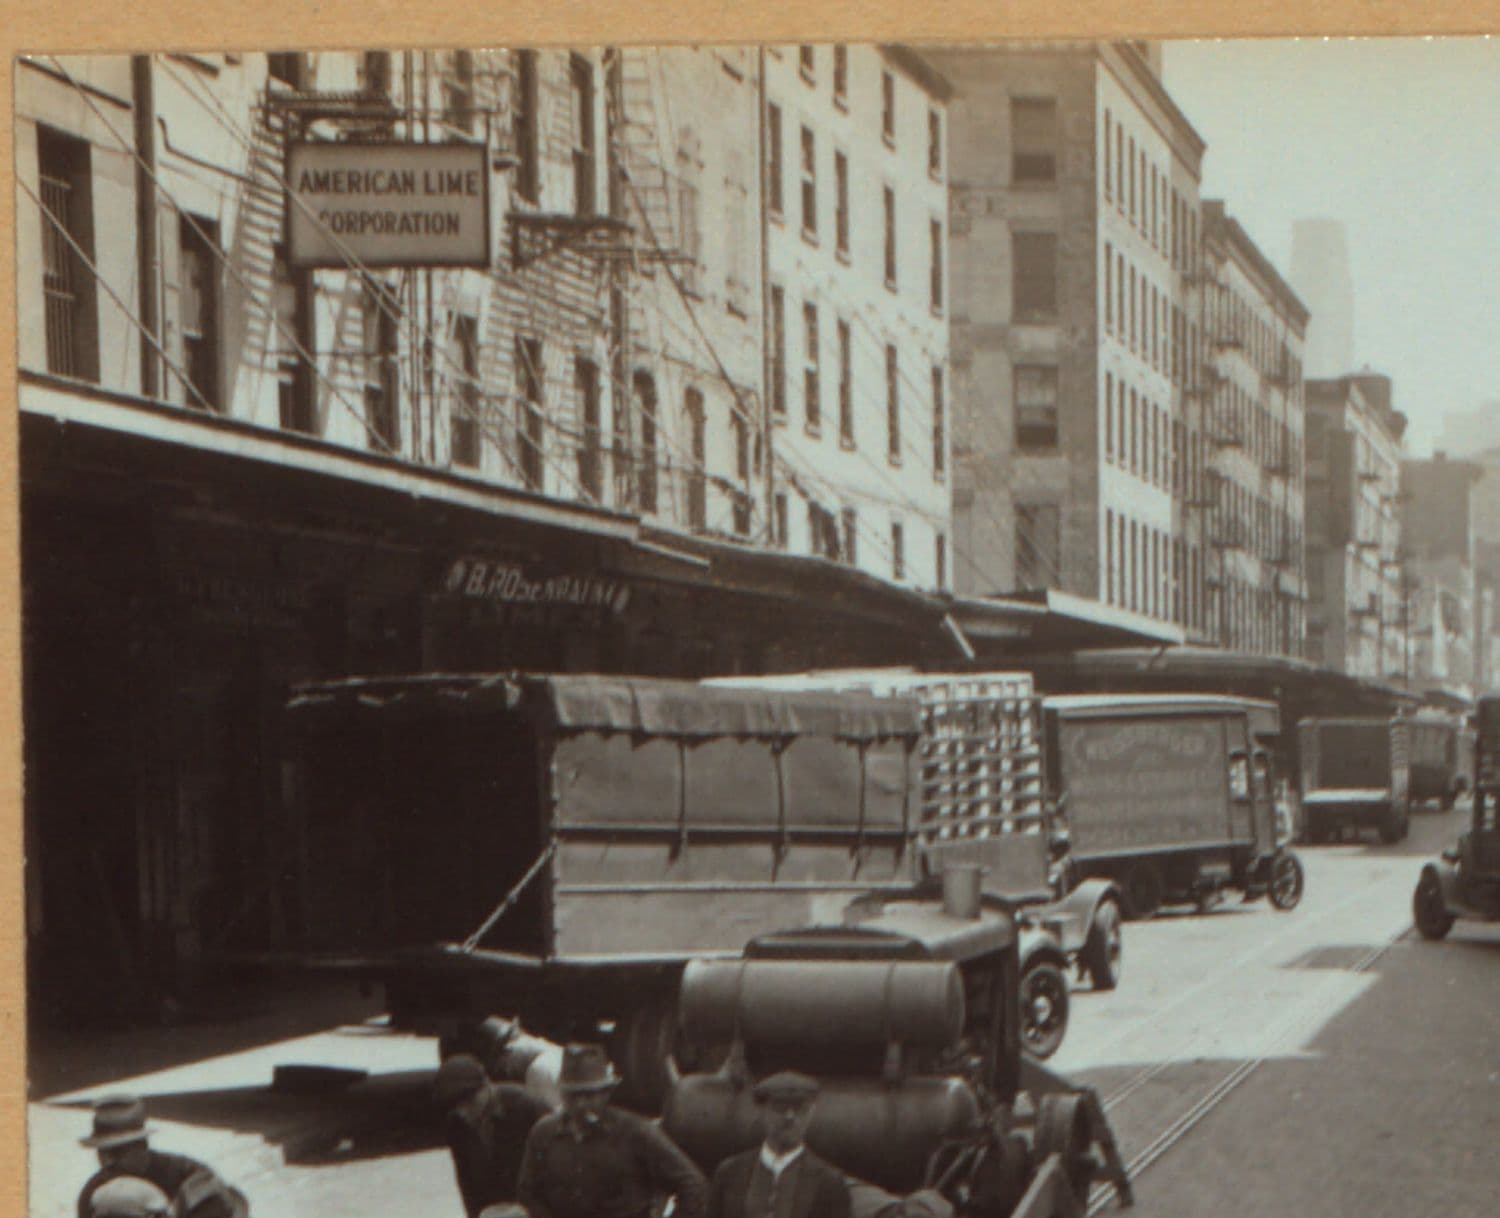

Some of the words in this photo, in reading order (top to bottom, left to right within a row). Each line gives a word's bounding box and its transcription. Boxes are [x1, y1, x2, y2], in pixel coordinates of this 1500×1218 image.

[299, 169, 416, 195] AMERICAN
[424, 170, 480, 197] LIME
[319, 209, 461, 235] CORPORATION
